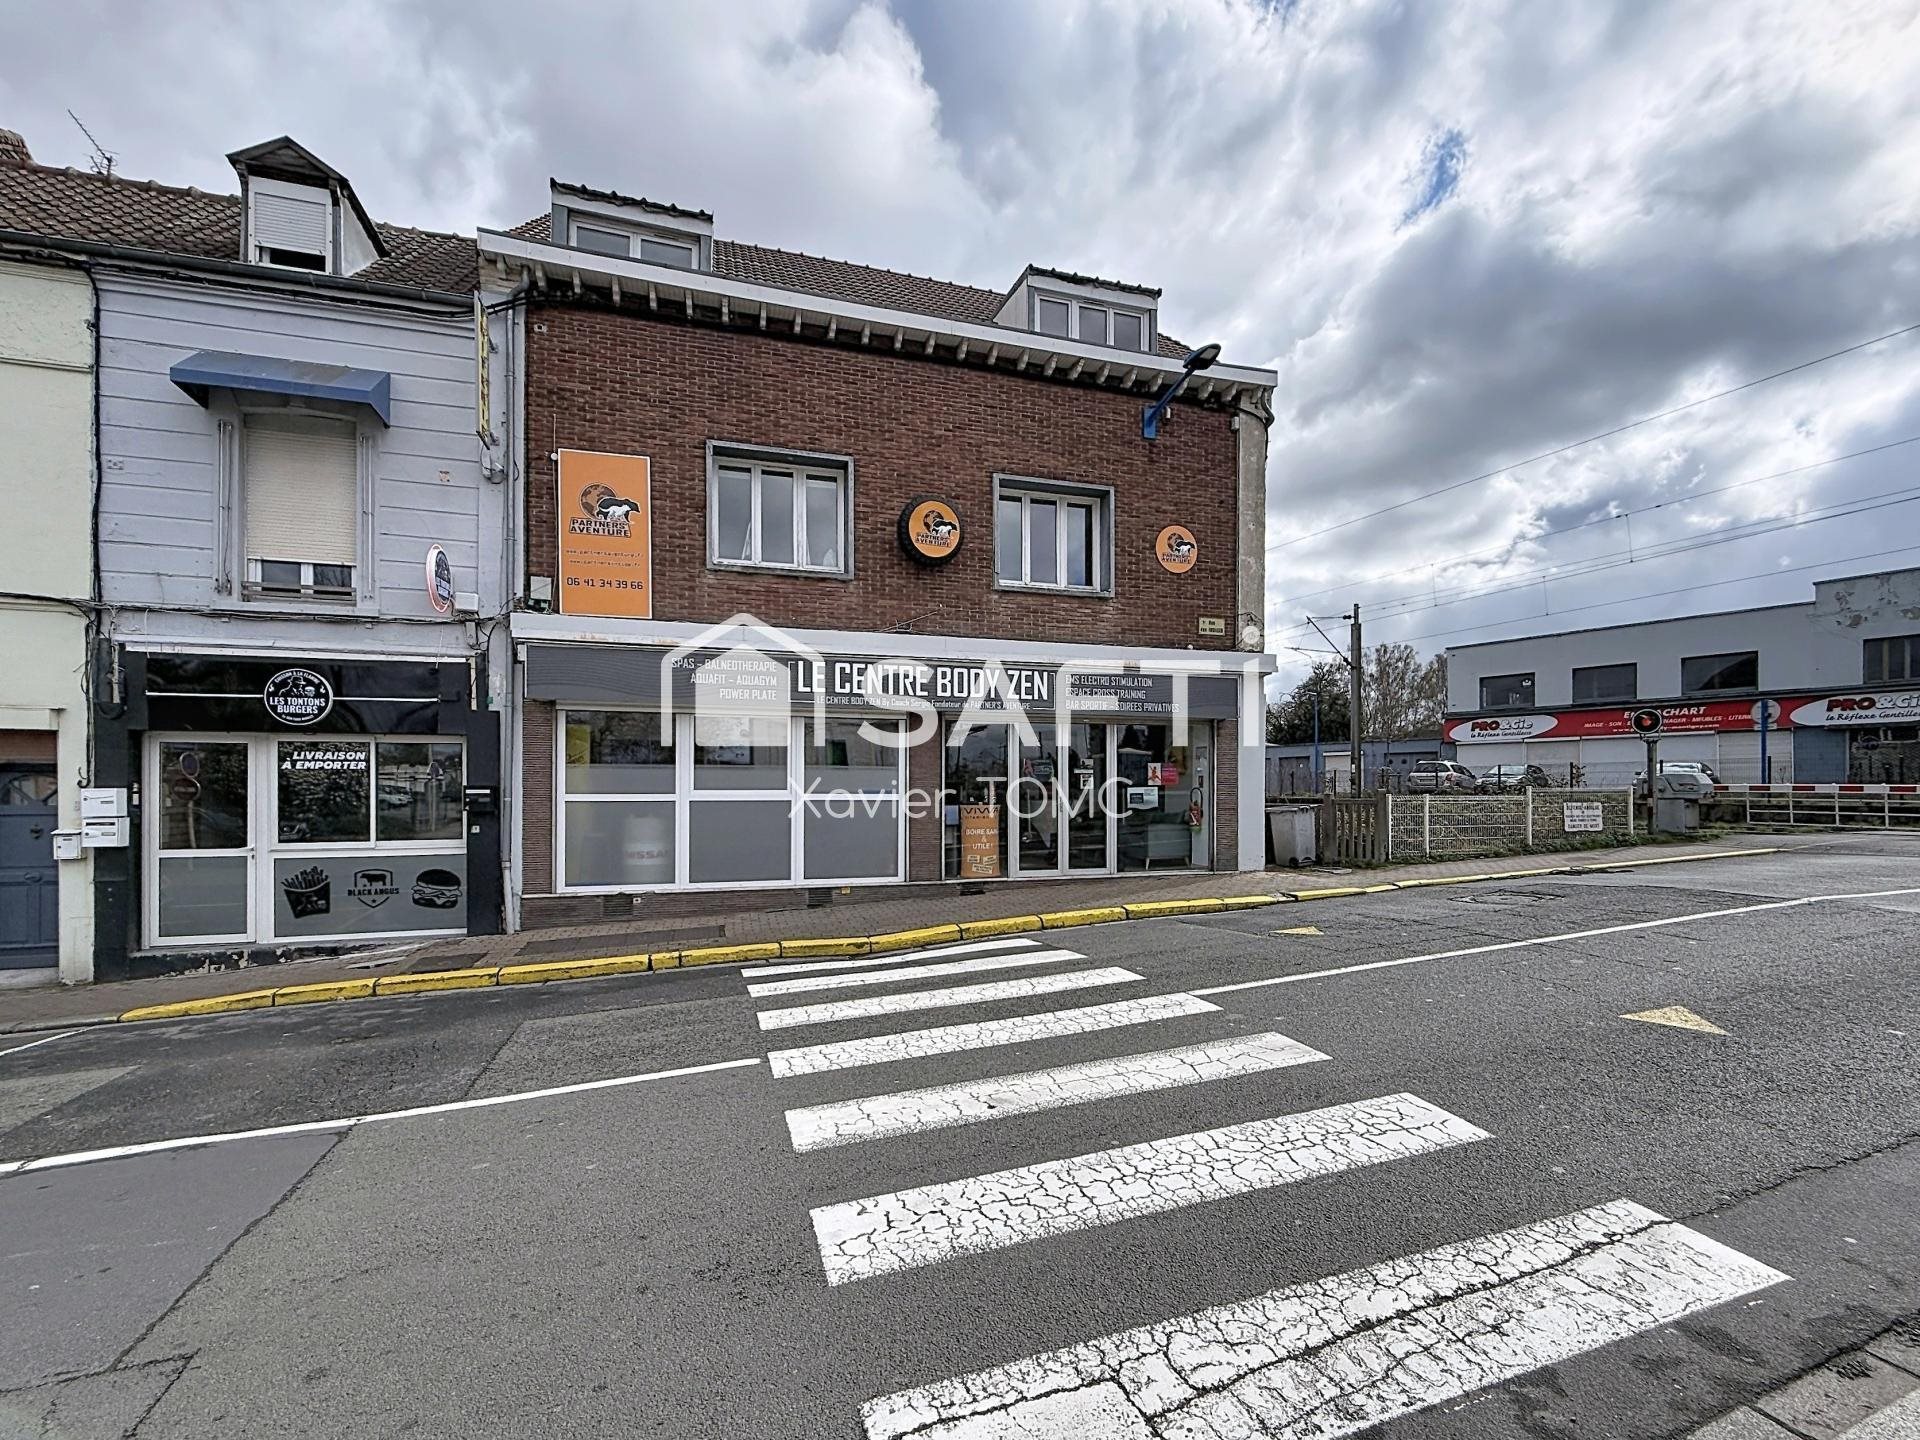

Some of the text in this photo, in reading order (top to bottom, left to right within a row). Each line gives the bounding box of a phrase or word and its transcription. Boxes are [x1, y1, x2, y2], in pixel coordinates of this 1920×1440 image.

[570, 526, 630, 536] AVENTURE
[566, 576, 644, 590] 06 41 34 39 66
[672, 658, 694, 668] SPAS
[705, 659, 776, 672] BALNEOTHERAPIE
[690, 673, 725, 684] AQUAFIT
[736, 675, 776, 686] AQUAGYM
[798, 660, 1048, 700] LE CENTRE BODY ZEN
[1082, 676, 1109, 685] ELECTRO
[1111, 676, 1152, 687] STIMULATION
[720, 689, 776, 700] POWER PLATE
[1066, 688, 1146, 699] ESPACE CROSS TRAINING
[270, 697, 326, 706] LES TONTONS
[826, 696, 850, 704] CENTRE
[851, 696, 868, 705] BODY
[1066, 700, 1078, 709] BAR
[1115, 702, 1142, 711] SOIREES
[1144, 702, 1180, 712] PRIVATIVES
[1826, 694, 1920, 712] PRO&Ci
[277, 705, 318, 714] BURGERS
[292, 751, 366, 760] LIVRAISON
[280, 757, 366, 769] À EMPORTER
